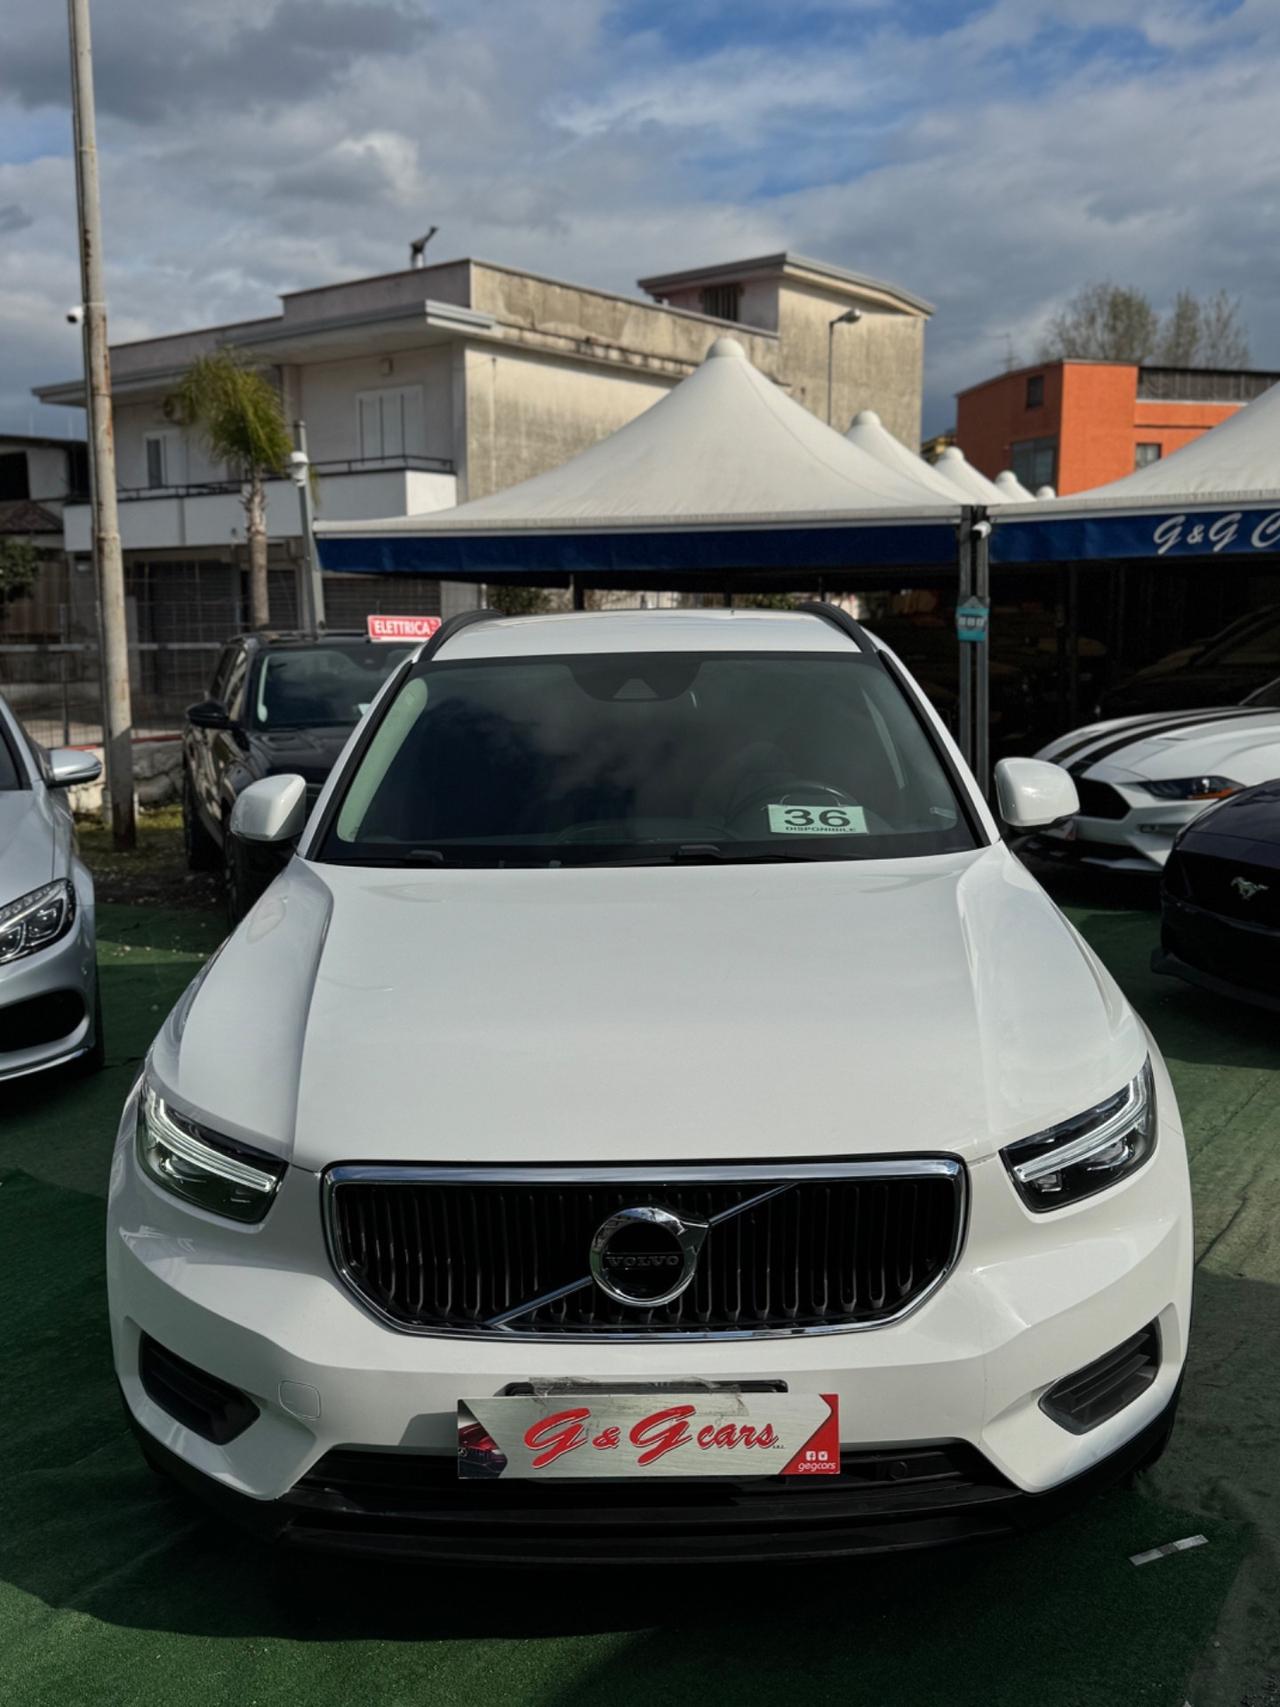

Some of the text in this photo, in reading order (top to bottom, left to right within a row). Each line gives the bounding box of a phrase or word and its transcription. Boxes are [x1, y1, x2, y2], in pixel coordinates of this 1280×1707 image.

[374, 620, 431, 635] ELETTRICA
[784, 808, 851, 828] 36
[605, 1255, 680, 1267] VOLVO
[798, 1462, 837, 1472] gegcars
